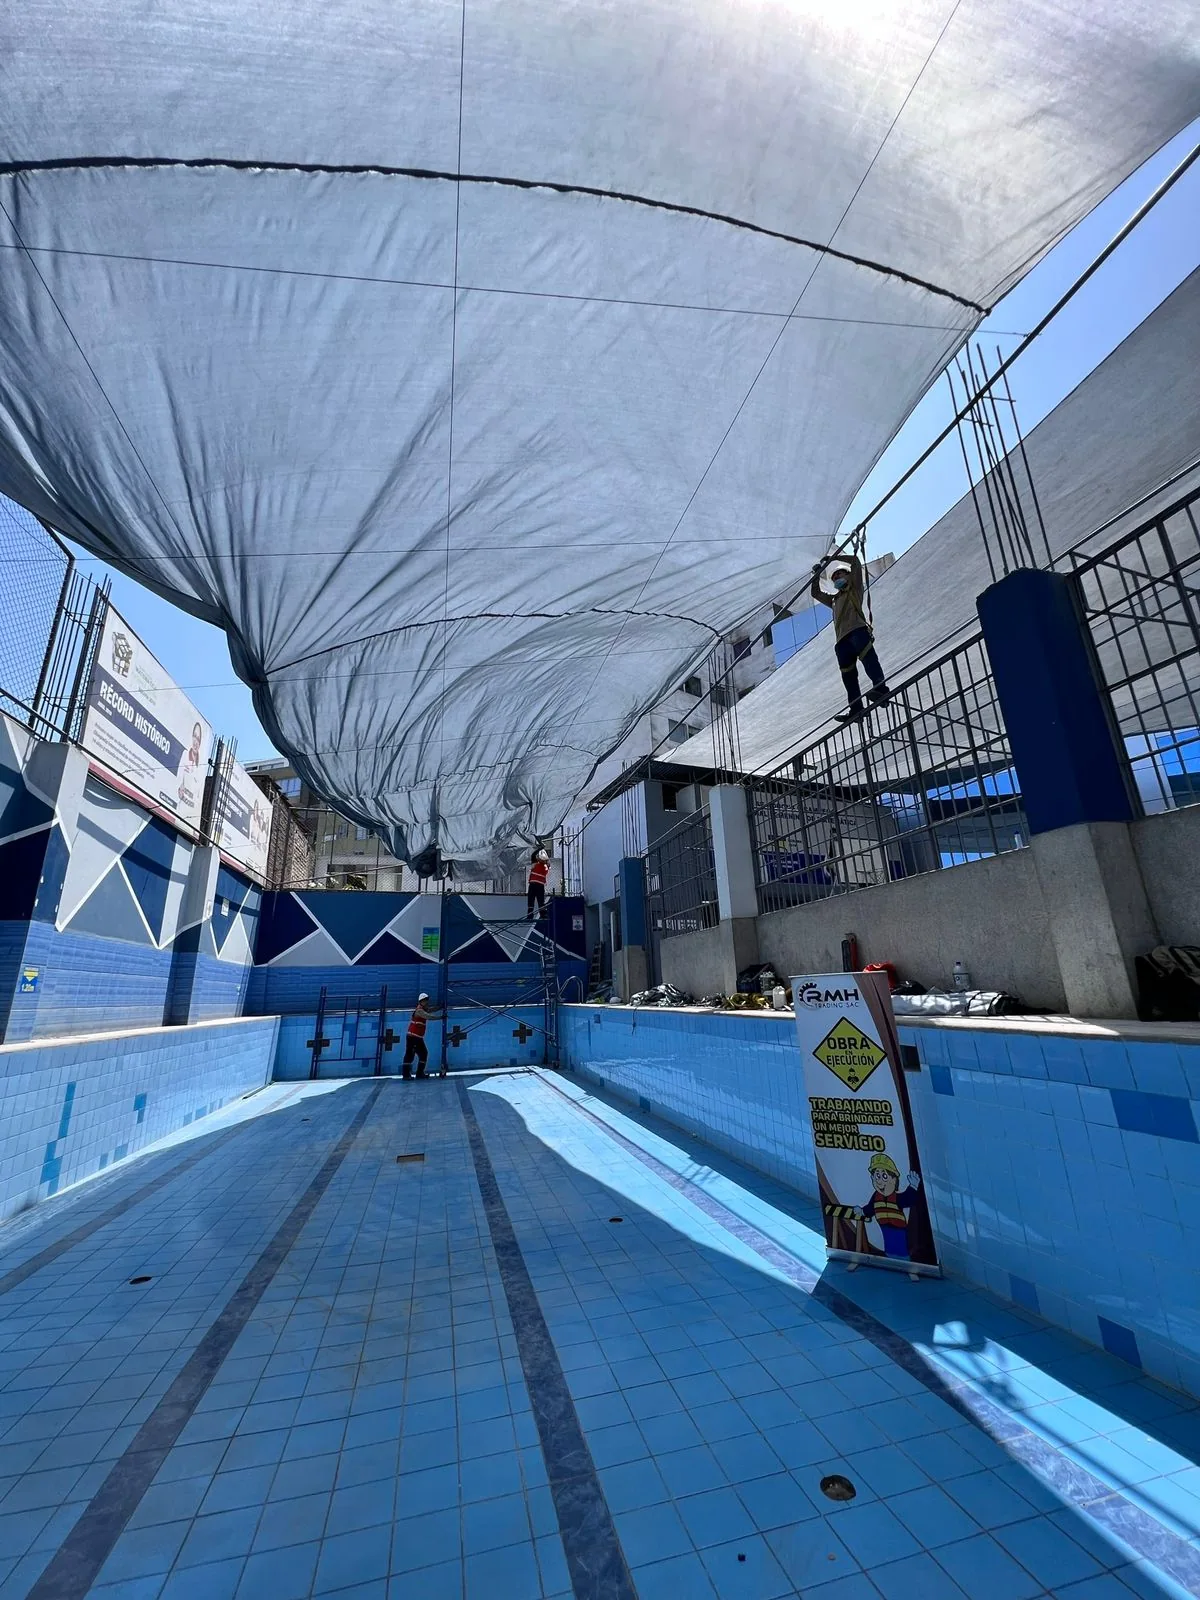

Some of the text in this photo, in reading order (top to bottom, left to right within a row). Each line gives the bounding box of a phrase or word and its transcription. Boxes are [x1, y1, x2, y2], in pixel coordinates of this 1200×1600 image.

[100, 681, 135, 723] RÉCORD
[134, 713, 171, 755] HISTÓRICO
[806, 988, 859, 1002] RMH
[827, 1037, 871, 1050] OBRA
[826, 1053, 875, 1067] EJECUCIÓN
[809, 1098, 891, 1113] TRABAJANDO
[812, 1111, 892, 1125] PARA BRINDARTE
[813, 1122, 859, 1134] UN MEJOR
[815, 1133, 885, 1152] SERVICIO
